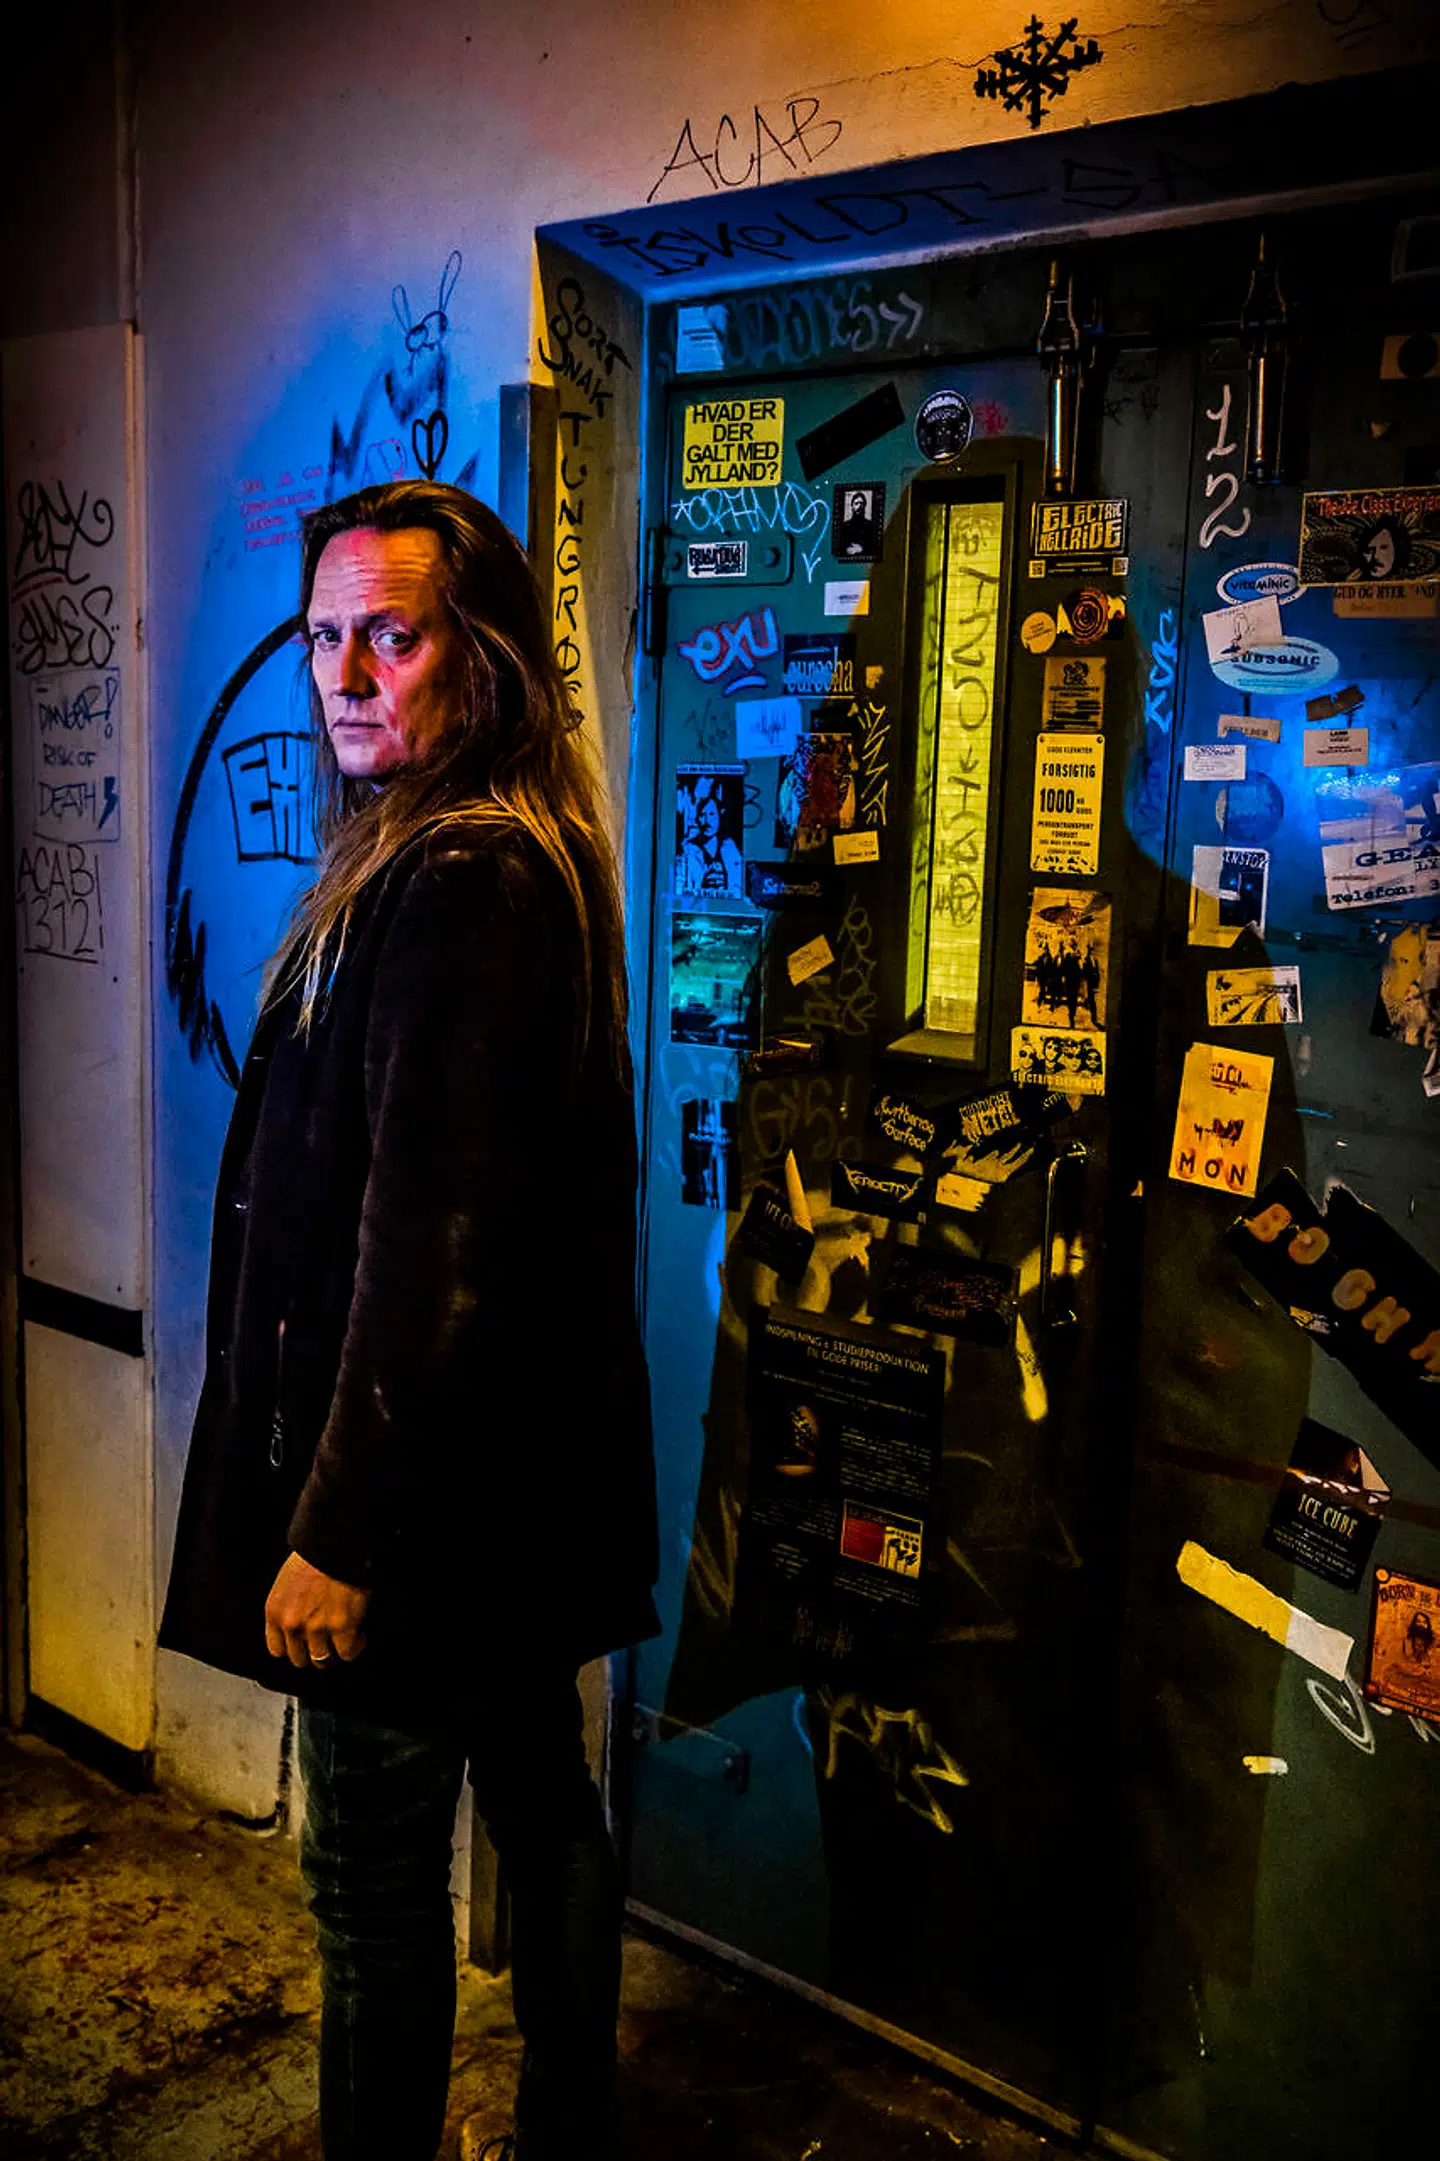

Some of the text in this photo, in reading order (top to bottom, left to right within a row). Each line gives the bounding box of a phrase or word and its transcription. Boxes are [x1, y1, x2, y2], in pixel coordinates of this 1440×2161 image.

[646, 97, 842, 203] ACAB
[693, 401, 776, 424] HVAD ER
[712, 423, 754, 443] DER
[687, 441, 779, 464] GALT MED
[685, 461, 779, 484] JYLLAND?
[1042, 763, 1096, 778] FORSIGTIG
[1040, 788, 1075, 813] 1000
